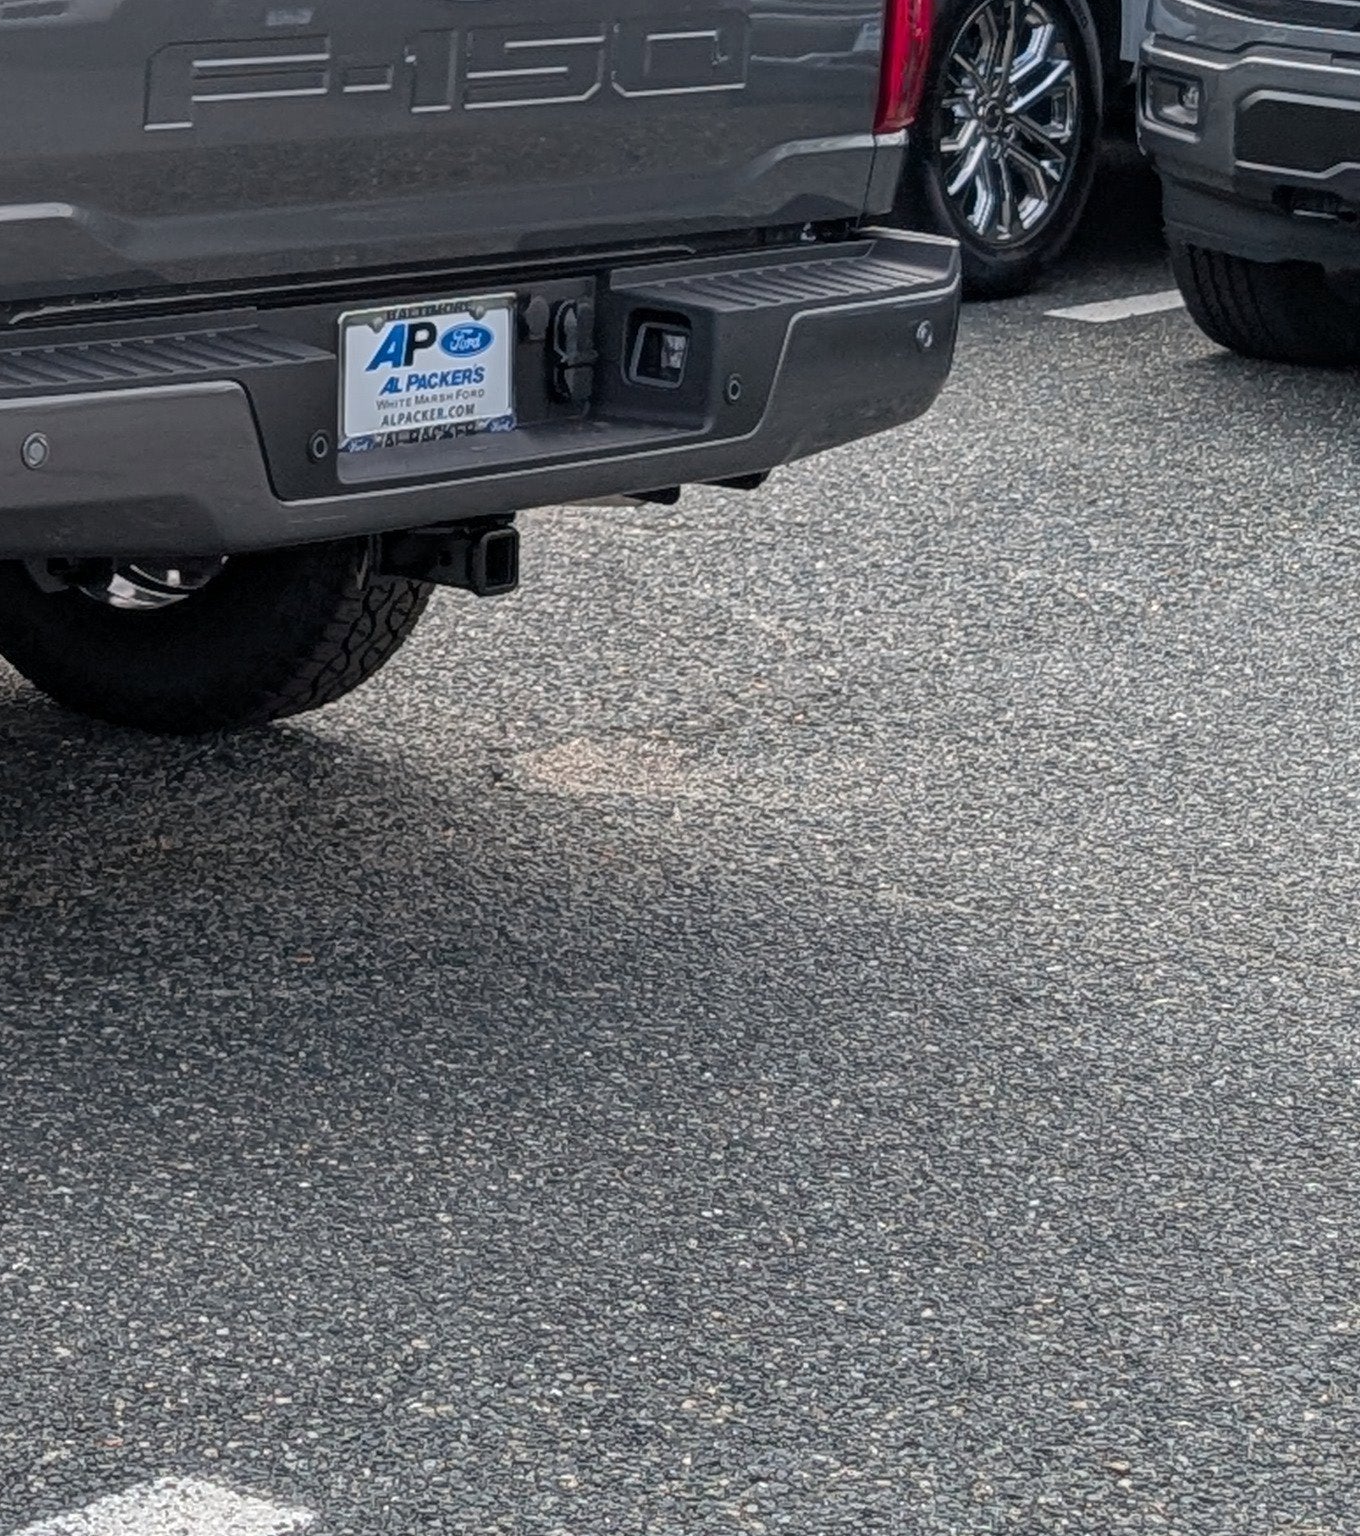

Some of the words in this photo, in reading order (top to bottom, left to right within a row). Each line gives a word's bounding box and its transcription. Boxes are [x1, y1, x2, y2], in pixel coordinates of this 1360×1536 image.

[144, 10, 748, 131] F-150
[365, 322, 437, 372] AP
[380, 376, 403, 396] AL
[406, 364, 485, 392] PACKER'S
[376, 397, 412, 411] WHITE
[415, 392, 453, 407] MARSH
[456, 388, 485, 400] FORD
[381, 404, 475, 427] ALPACKER.COM
